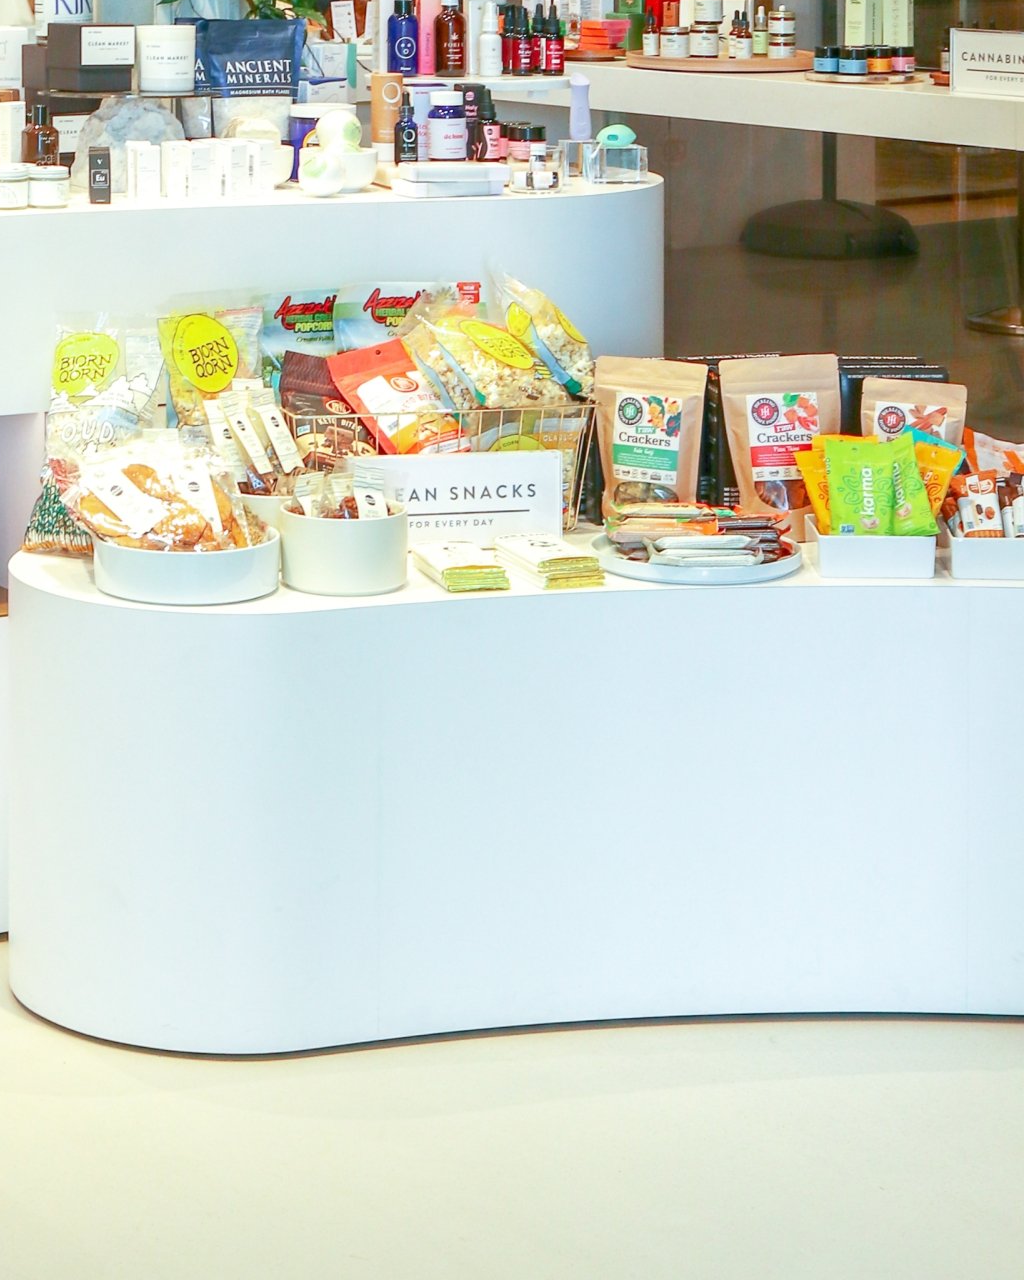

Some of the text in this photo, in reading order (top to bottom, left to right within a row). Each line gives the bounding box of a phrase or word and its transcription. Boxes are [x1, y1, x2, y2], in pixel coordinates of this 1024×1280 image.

[225, 59, 292, 73] ANCIENT
[226, 73, 292, 84] MINERALS
[188, 336, 231, 364] BJORN
[60, 353, 112, 370] BJORN
[194, 354, 234, 379] QORN
[59, 367, 106, 383] QORN
[618, 431, 671, 447] Crackers
[757, 433, 813, 444] Crackers
[395, 483, 536, 502] EAN SNACKS
[859, 467, 875, 516] karma
[409, 518, 494, 529] FOR EVERY DAY
